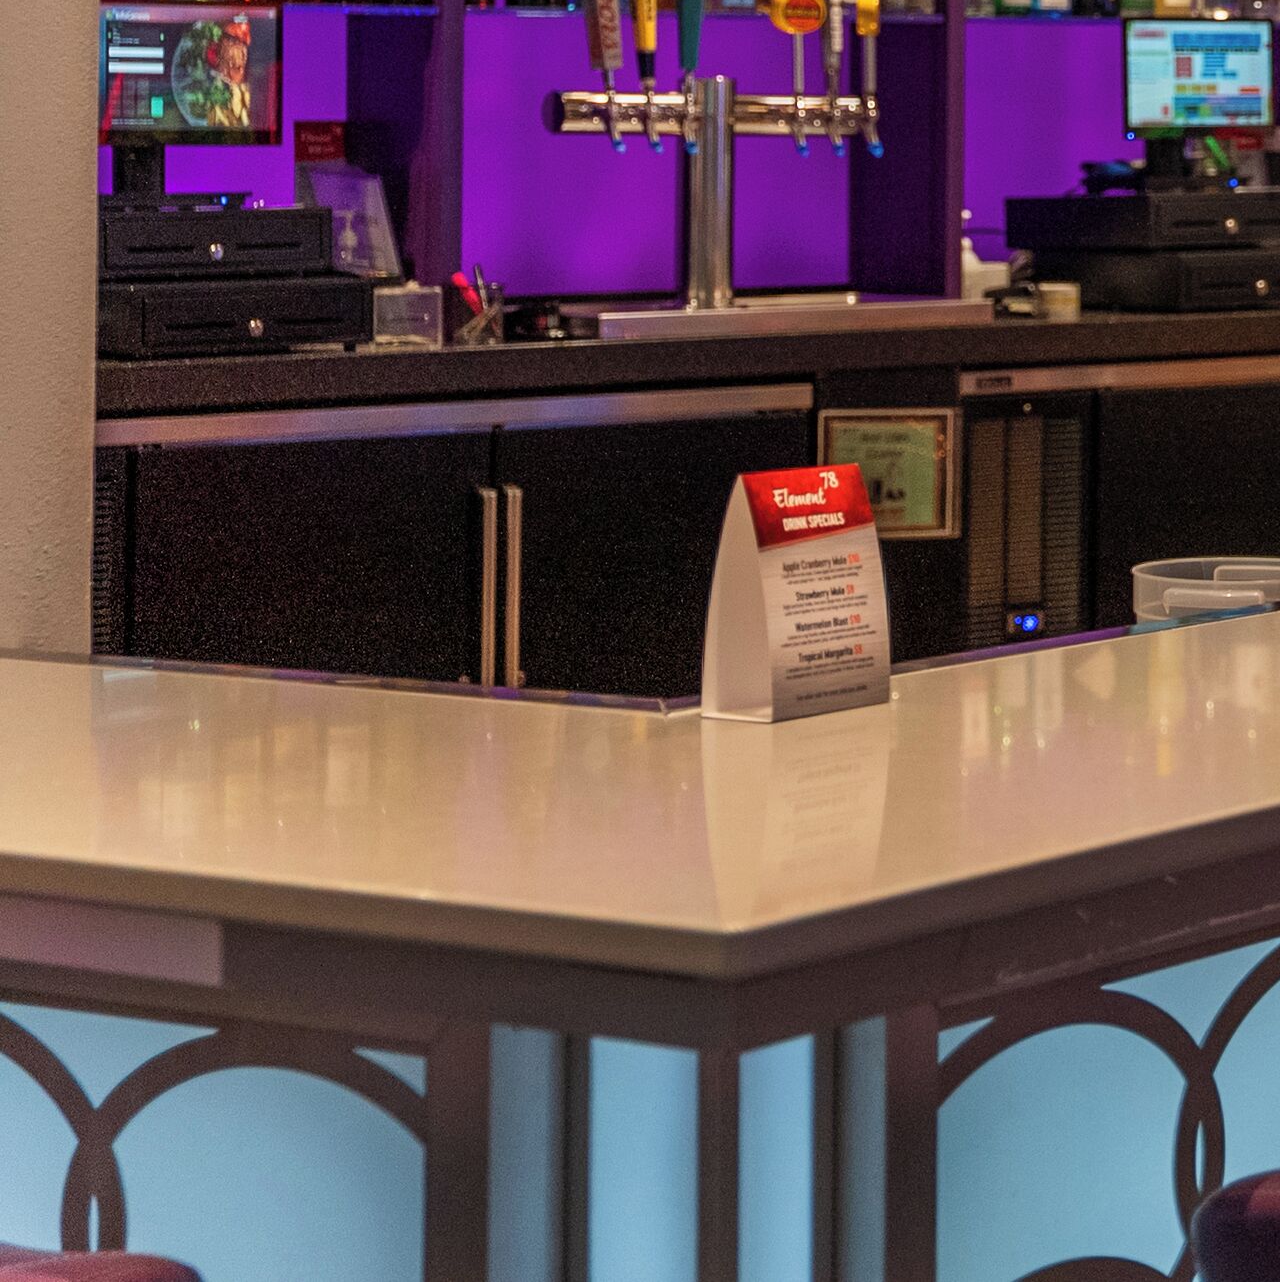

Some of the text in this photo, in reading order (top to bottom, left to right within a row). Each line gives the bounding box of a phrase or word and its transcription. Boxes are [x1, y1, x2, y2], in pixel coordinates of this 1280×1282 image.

[773, 471, 839, 508] Element 78
[782, 511, 845, 531] DRINK SPECIALS
[783, 561, 800, 573] Apple
[801, 558, 831, 571] Cranberry
[795, 590, 830, 602] Strawberry
[795, 620, 832, 632] Watermelon
